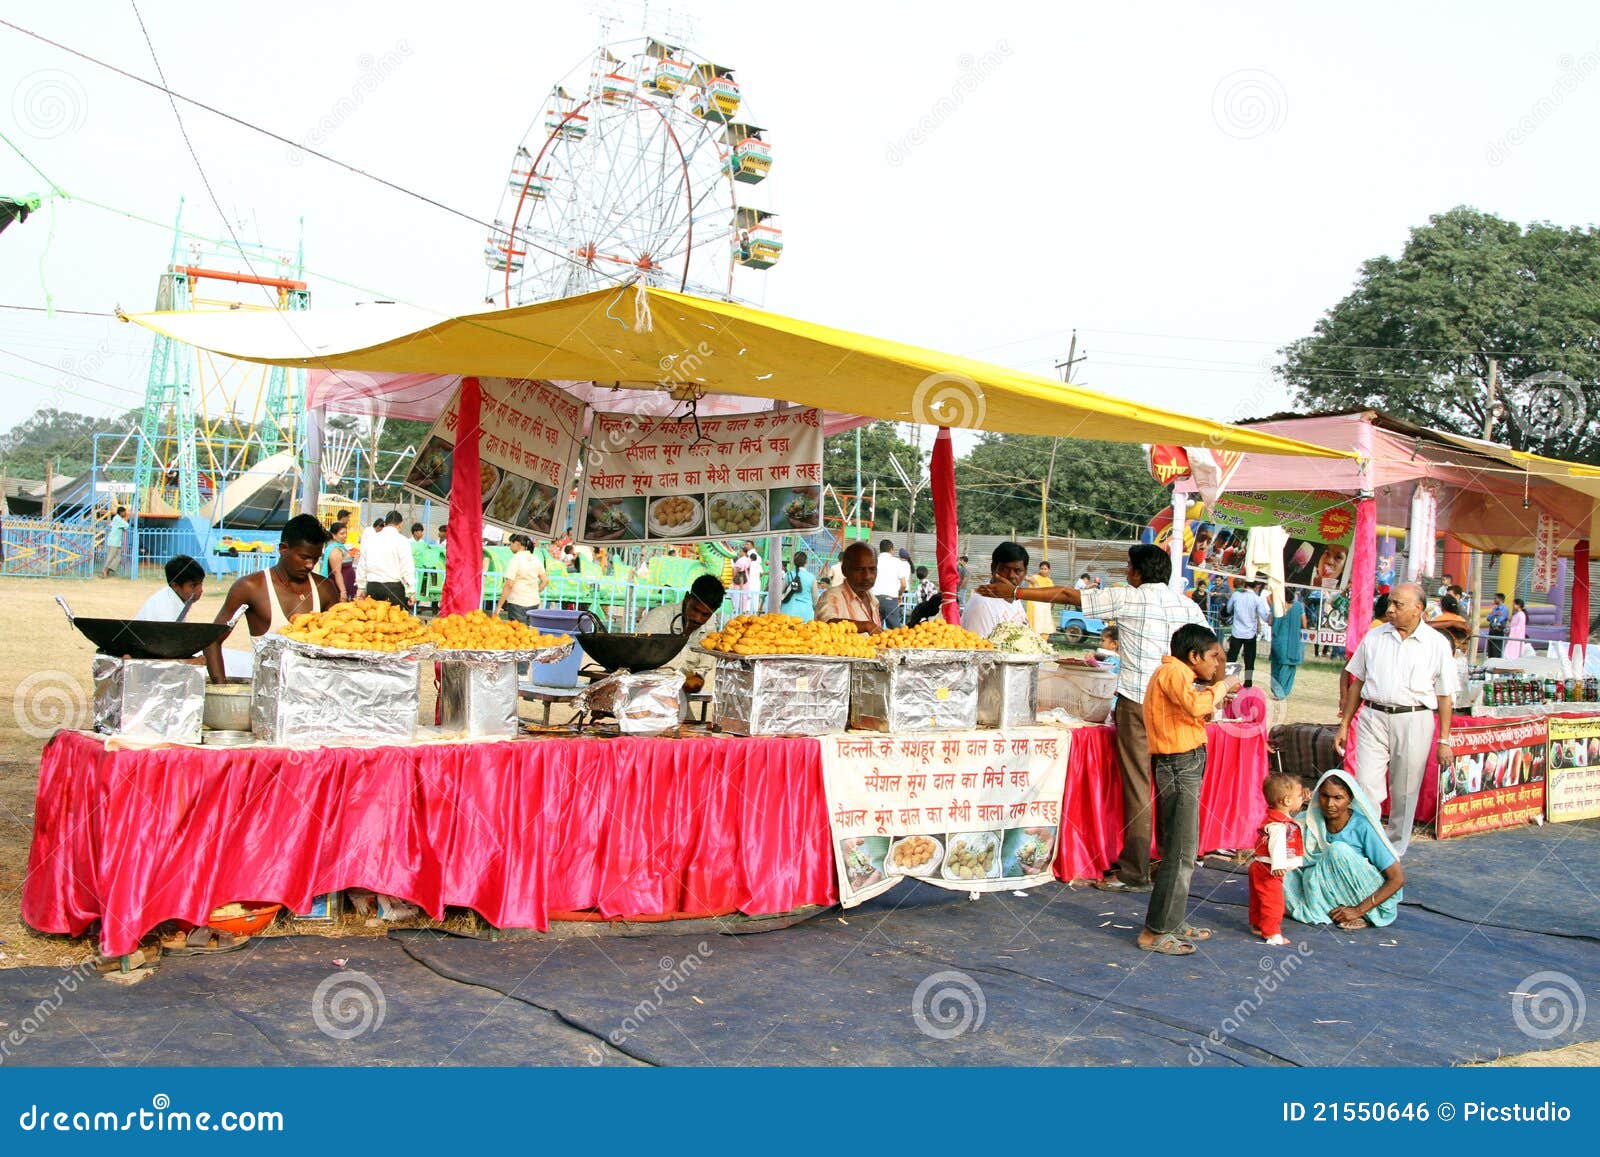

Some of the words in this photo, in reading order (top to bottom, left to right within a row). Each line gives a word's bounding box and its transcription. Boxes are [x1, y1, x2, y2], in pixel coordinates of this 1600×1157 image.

[638, 416, 654, 433] के
[660, 421, 697, 440] मशहूर
[726, 419, 750, 432] दाल
[754, 412, 768, 428] के
[772, 413, 790, 428] राम
[662, 442, 683, 464] मूंग
[717, 442, 735, 456] का
[739, 434, 763, 454] मिर्च
[768, 438, 790, 457] वड़ा
[632, 471, 653, 494] मूंग
[657, 473, 679, 488] दाल
[684, 471, 702, 486] का
[736, 467, 764, 482] वाला
[769, 465, 791, 480] राम
[900, 740, 937, 765] मशहूर
[966, 739, 988, 757] दाल
[993, 732, 1007, 757] के
[1011, 738, 1029, 756] राम
[907, 769, 927, 799] मूंग
[933, 773, 956, 791] दाल
[961, 773, 978, 789] का
[983, 765, 1007, 789] मिर्च
[1010, 771, 1030, 792] वड़ा
[875, 804, 894, 834] मूंग
[899, 808, 921, 826] दाल
[925, 807, 944, 824] का
[977, 804, 1004, 822] वाला
[1010, 803, 1028, 819] राम
